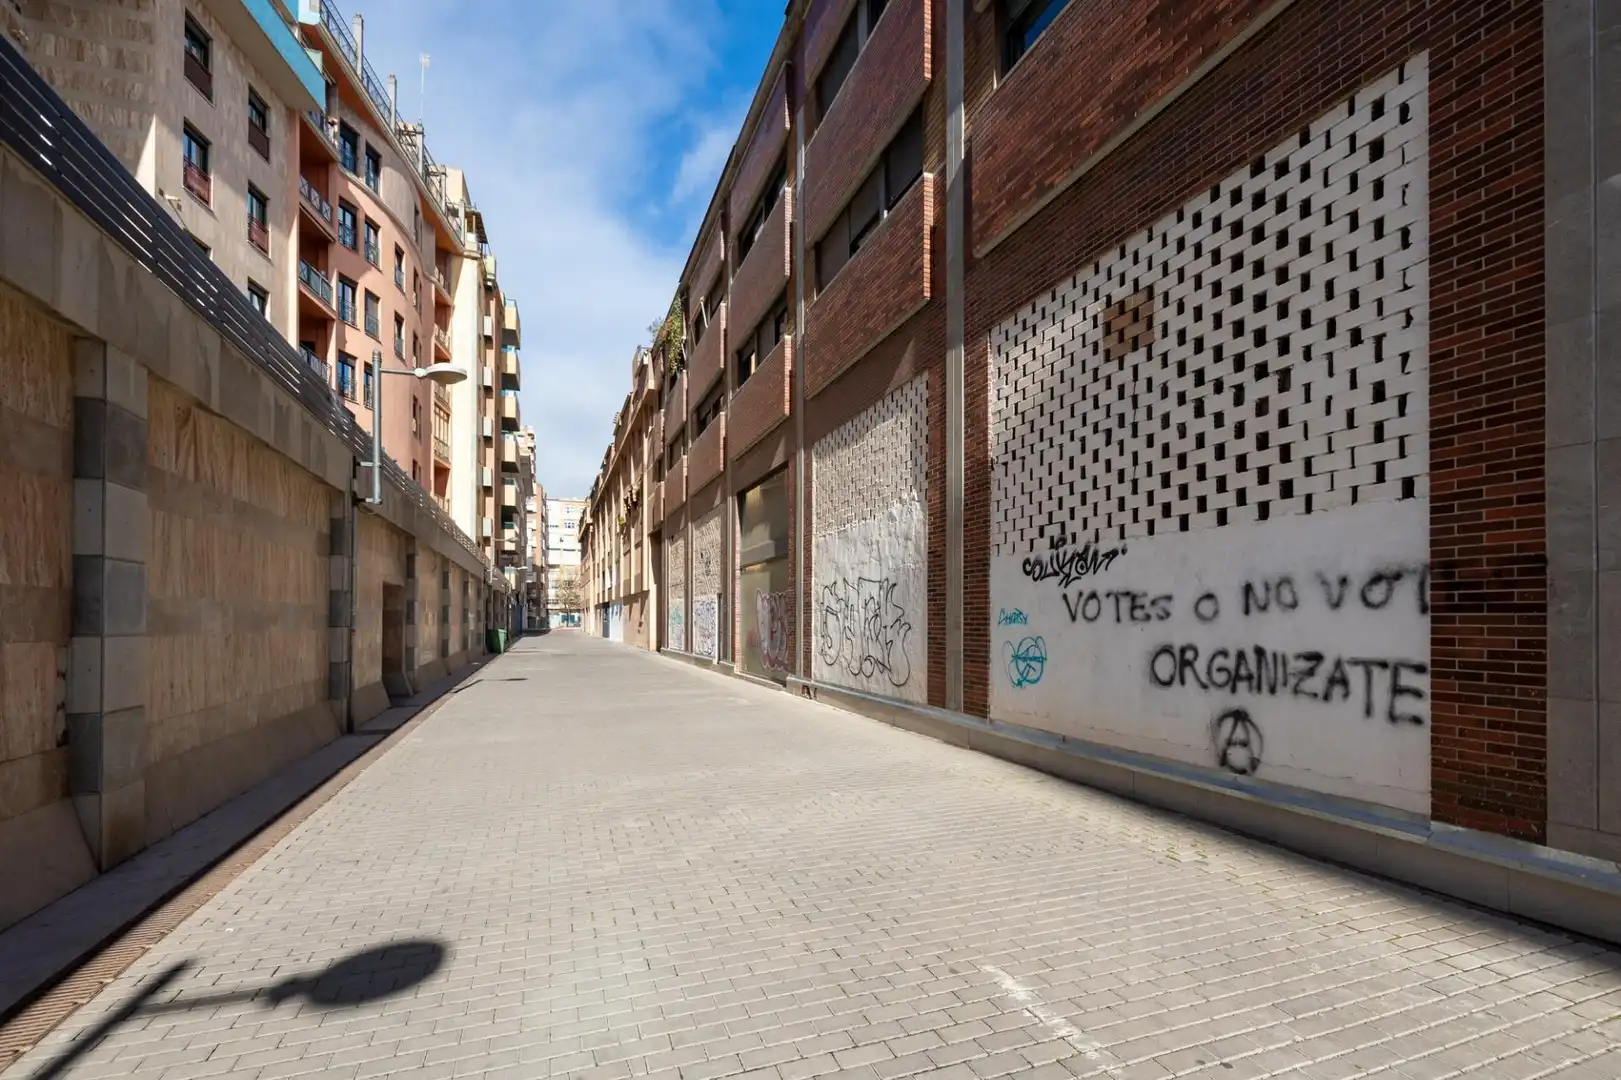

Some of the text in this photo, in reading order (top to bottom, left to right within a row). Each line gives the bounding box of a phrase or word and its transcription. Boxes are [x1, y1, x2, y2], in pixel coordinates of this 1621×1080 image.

[1063, 591, 1173, 624] VOTES
[1194, 592, 1220, 622] O
[1242, 575, 1299, 616] NO
[1150, 643, 1428, 726] ORGANIZATE
